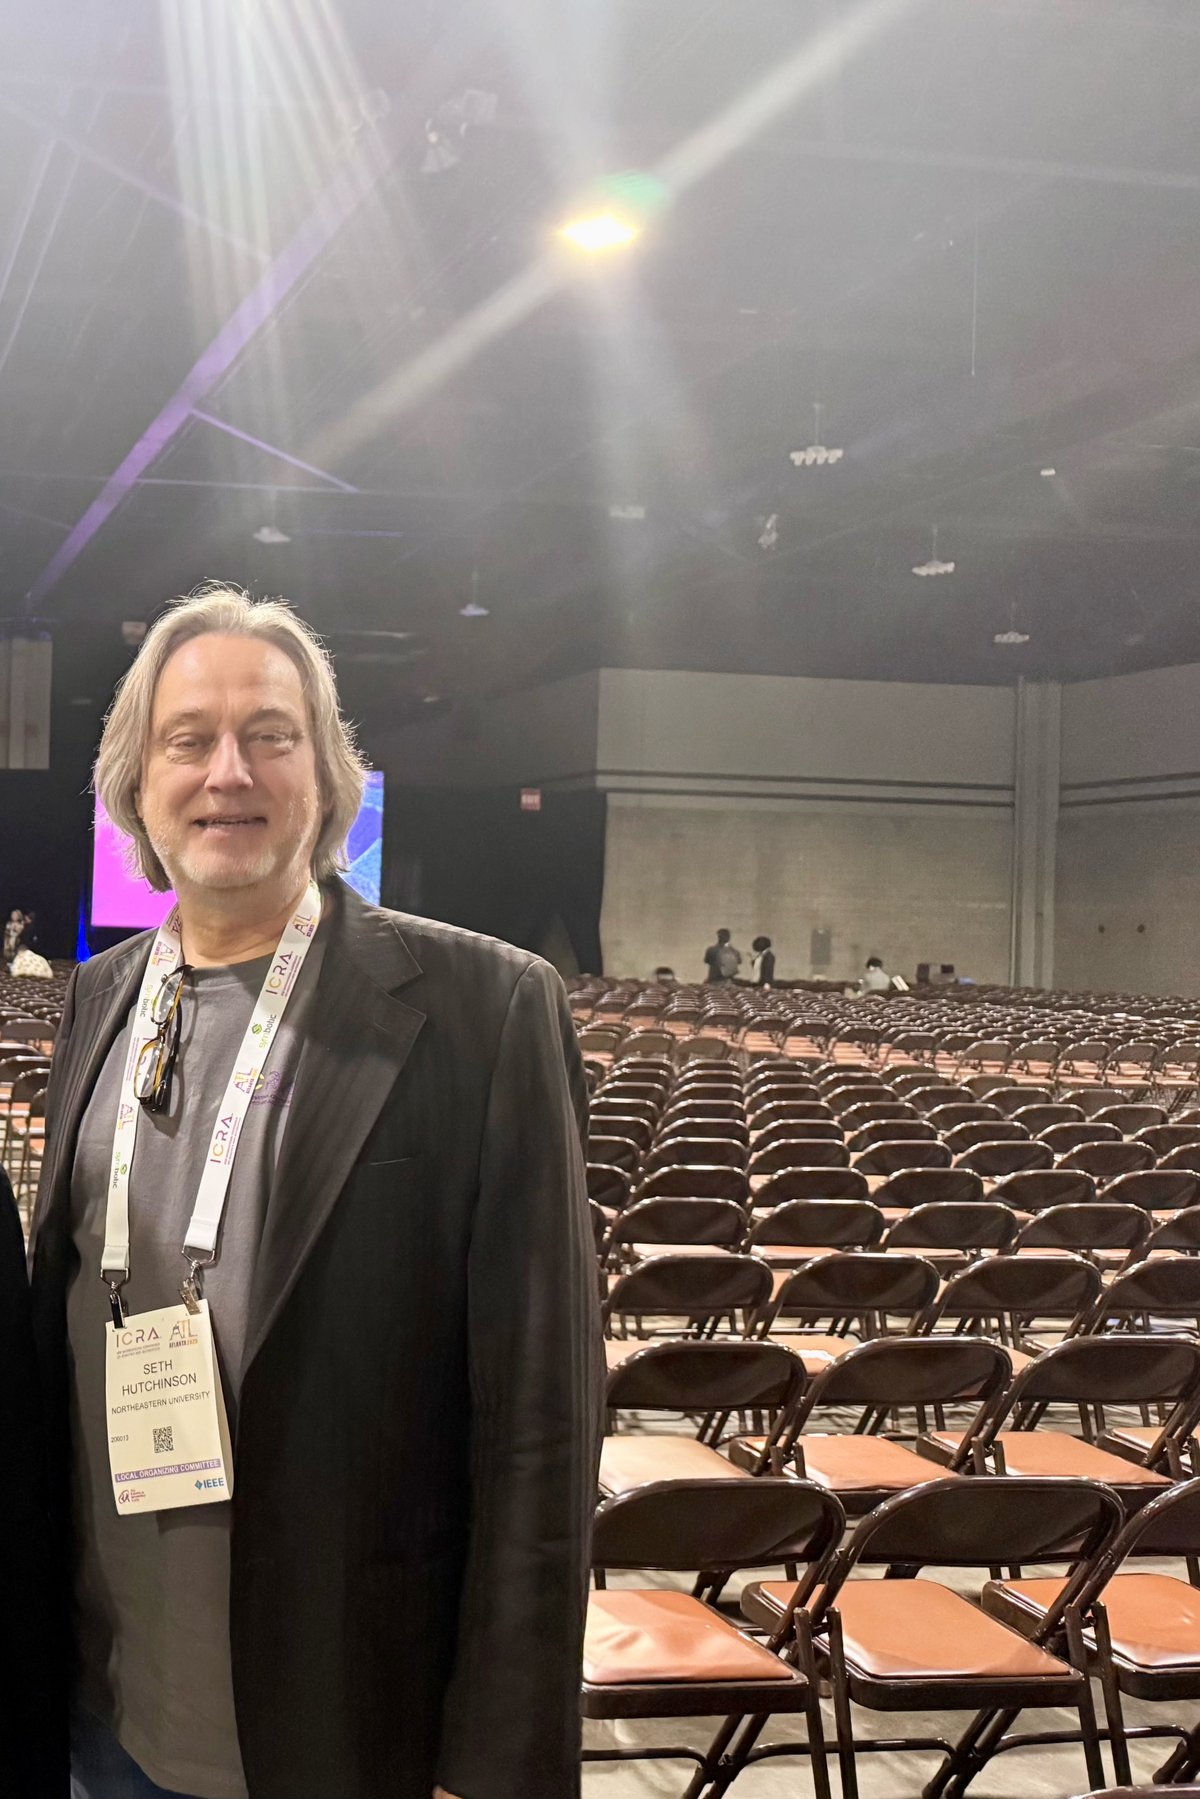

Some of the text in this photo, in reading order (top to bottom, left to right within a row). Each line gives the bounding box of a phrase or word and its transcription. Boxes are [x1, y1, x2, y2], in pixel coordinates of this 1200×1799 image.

[266, 952, 293, 995] ICRA
[210, 1113, 233, 1163] ICRA
[116, 1326, 160, 1348] ICRA
[143, 1359, 173, 1375] SETH
[121, 1372, 197, 1396] HUTCHINSON
[111, 1391, 211, 1415] NORTHEASTERN UNIVERSITY
[116, 1460, 220, 1481] LOCAL ORGANIZING COMMITTEE
[204, 1478, 225, 1489] IEEE
